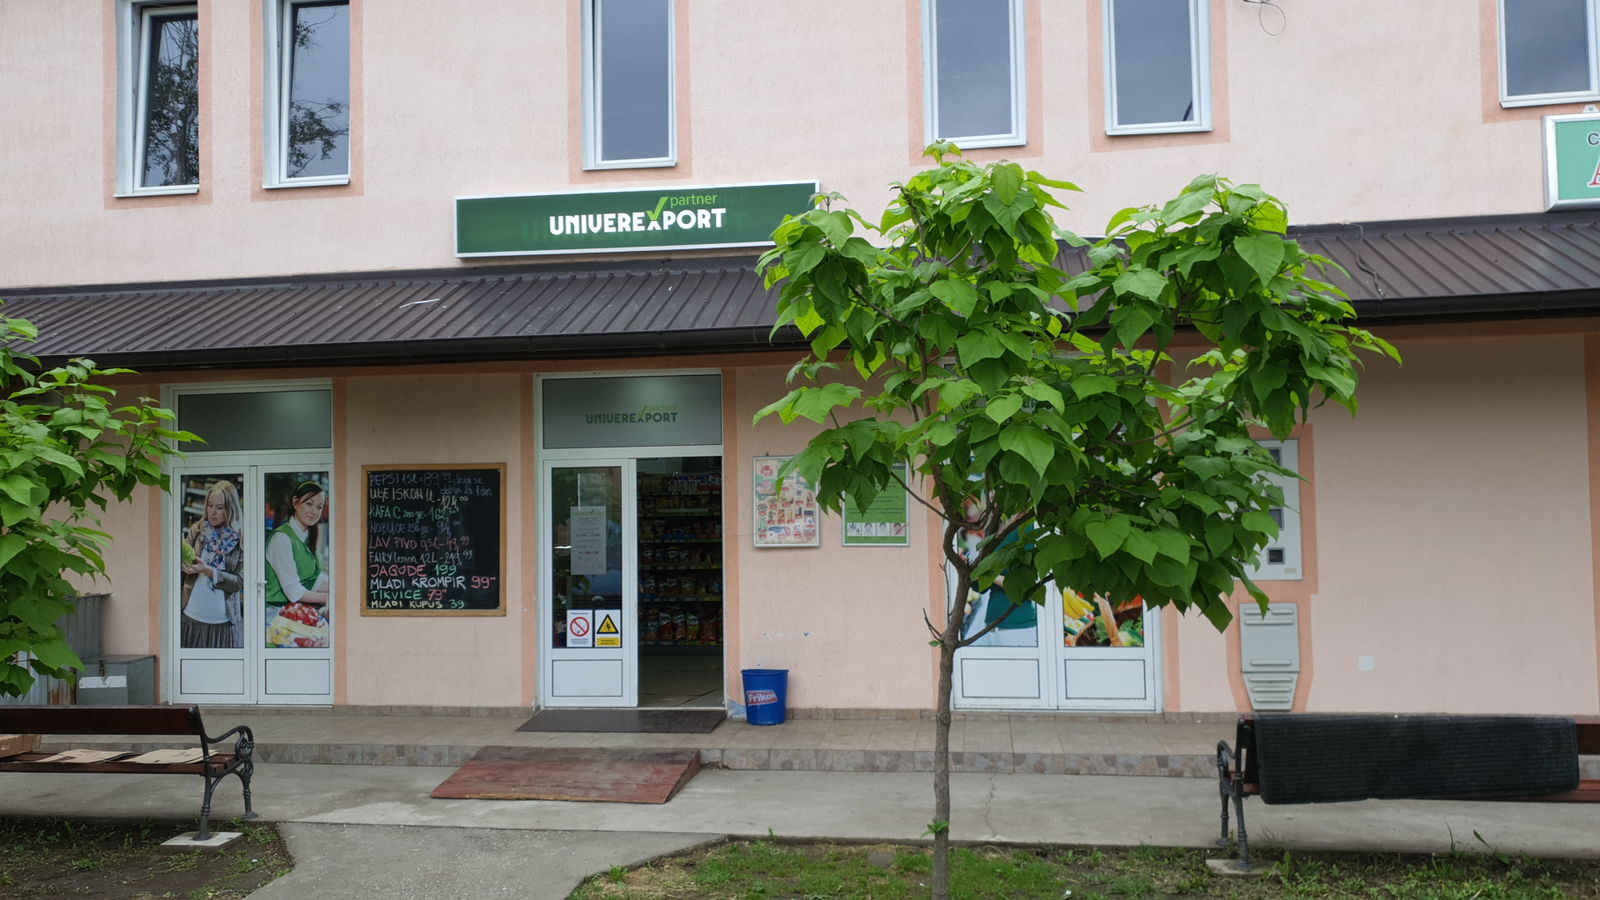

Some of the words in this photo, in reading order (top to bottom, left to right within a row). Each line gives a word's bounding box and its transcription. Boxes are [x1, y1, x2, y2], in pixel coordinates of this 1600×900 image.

[669, 193, 718, 209] partner
[549, 206, 727, 236] UNIVEREXPORT
[586, 411, 678, 424] UNIVEREXPORT
[369, 472, 399, 486] PEPSI
[392, 487, 424, 501] ISKON
[368, 502, 390, 519] KAFA
[368, 536, 390, 550] LAV
[392, 537, 418, 550] PIVO
[368, 551, 393, 564] FAIRY
[369, 564, 427, 578] JAGODE
[433, 564, 457, 577] 199
[370, 577, 406, 591] MLADI
[412, 576, 466, 590] KROMPIR
[370, 589, 423, 601] TIKVICE
[371, 600, 403, 610] MLADI
[409, 600, 443, 610] KUPUS
[449, 599, 465, 610] 39
